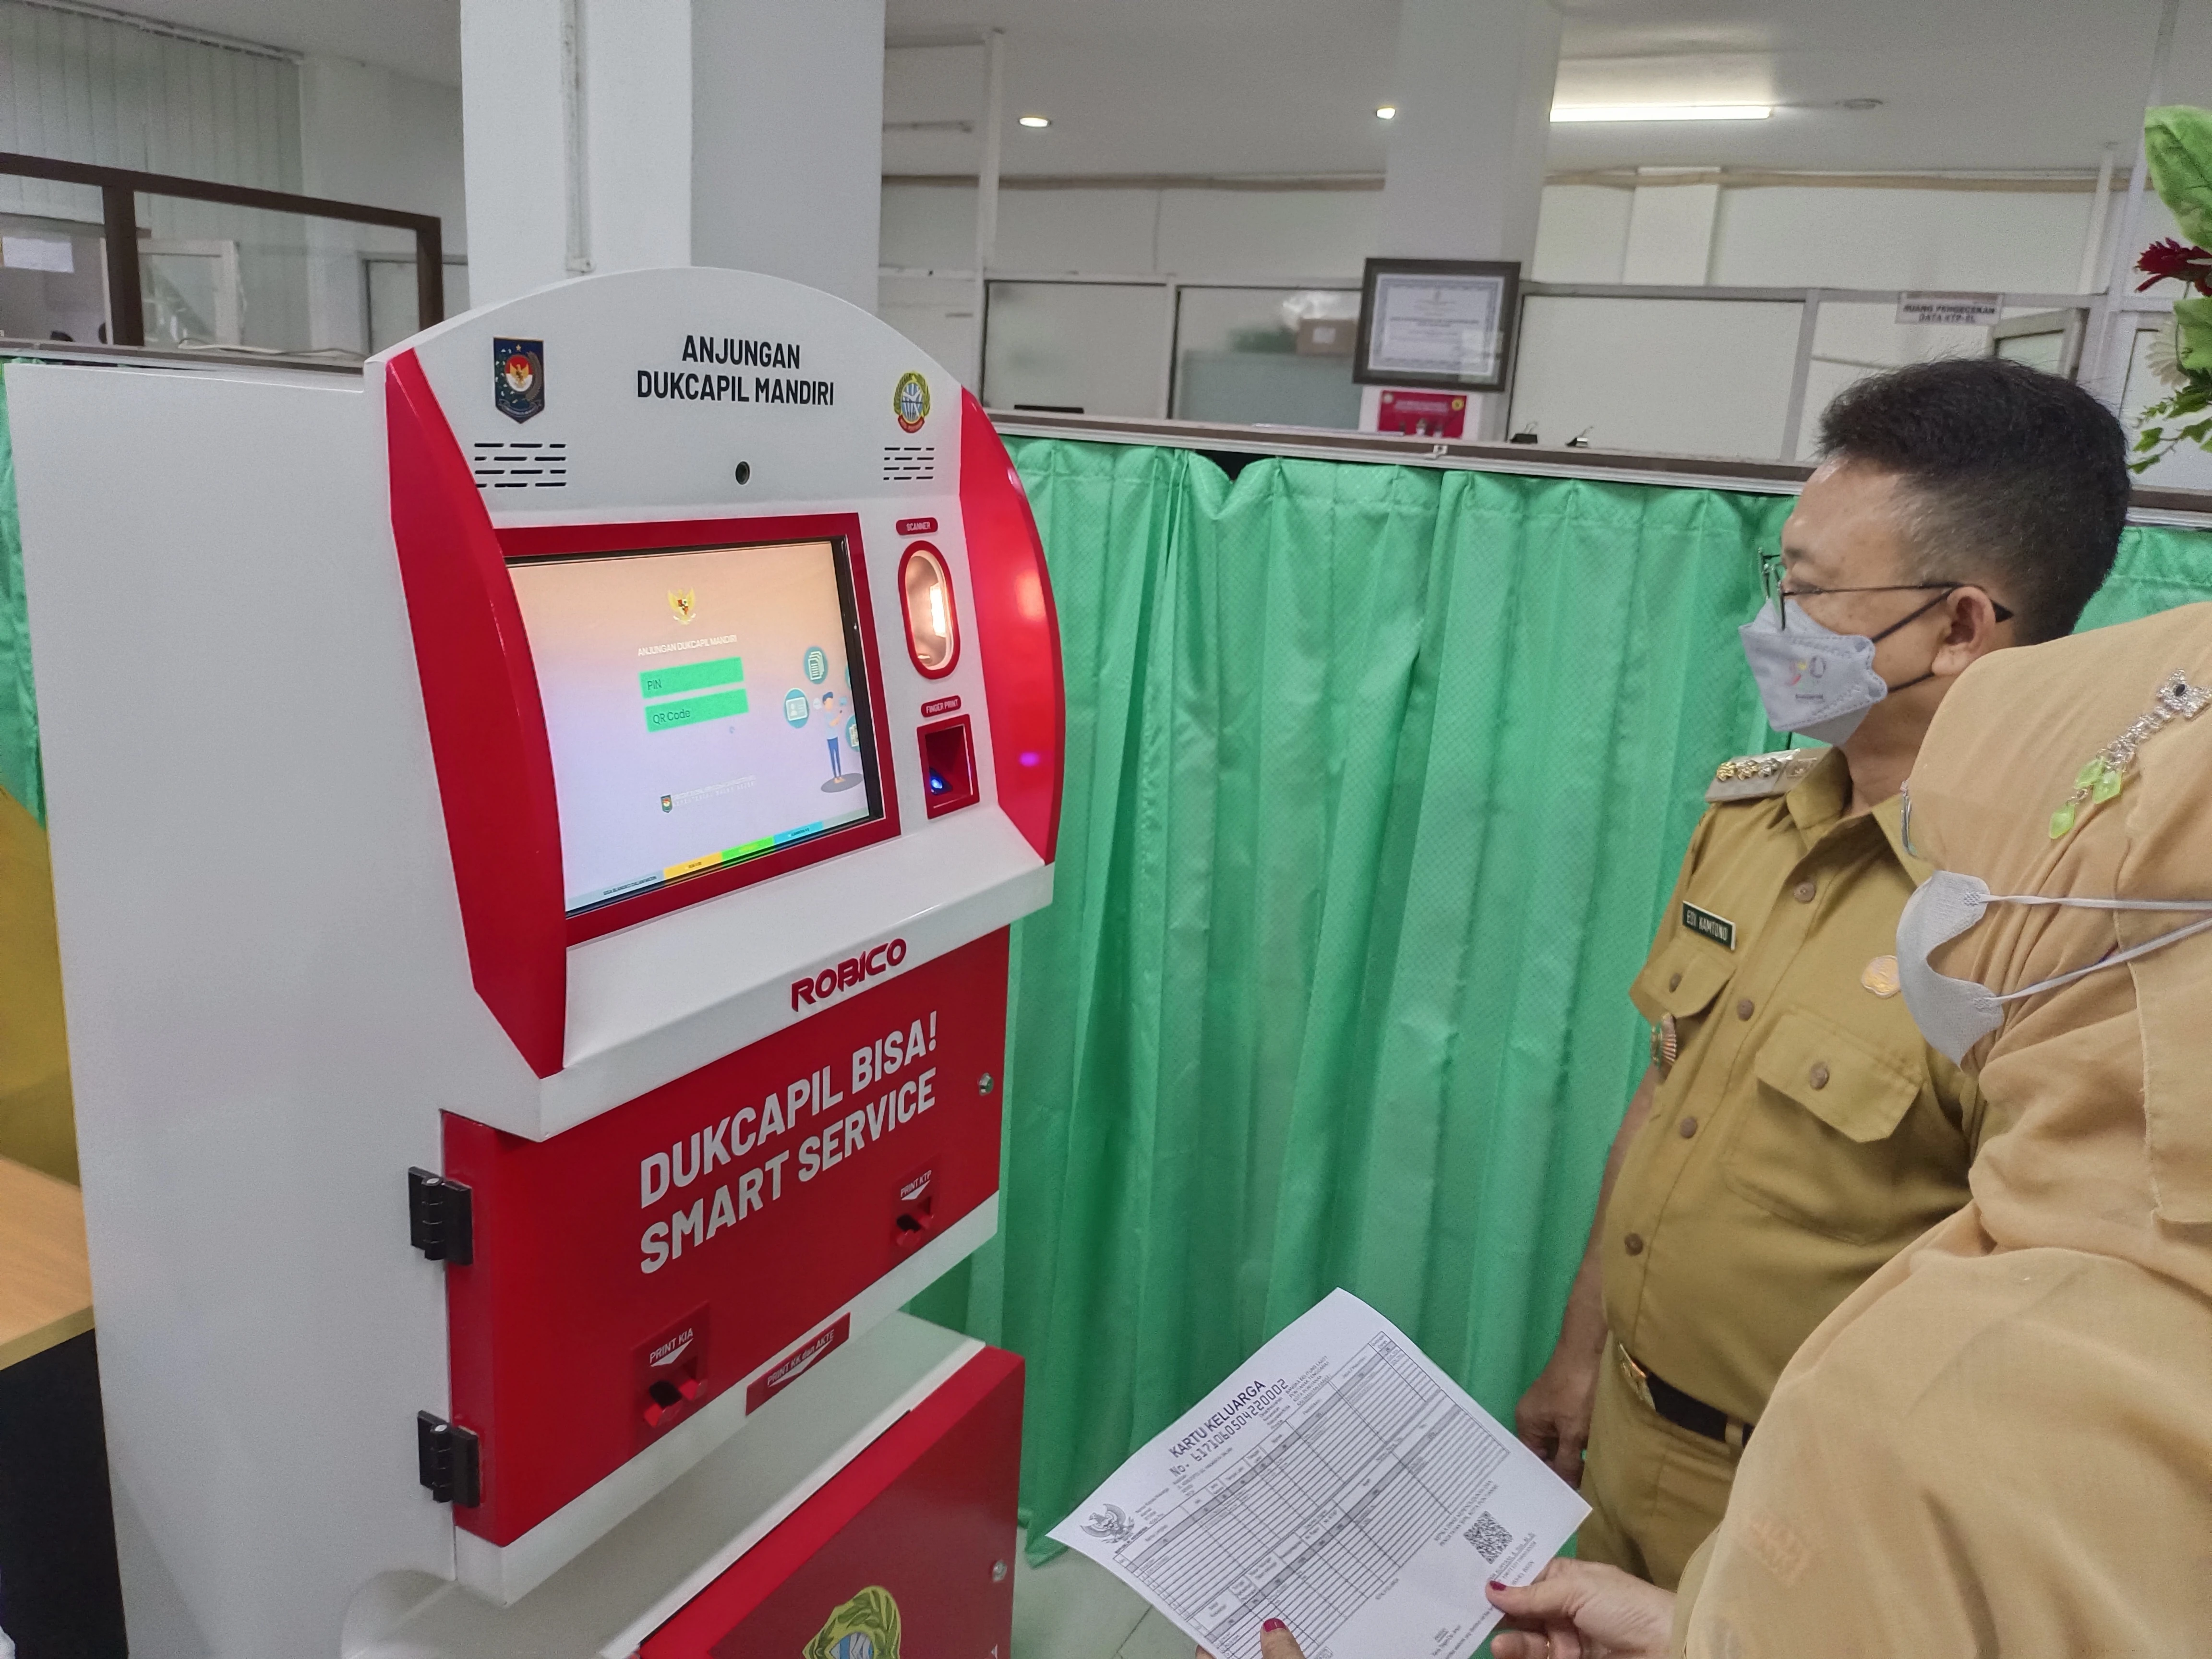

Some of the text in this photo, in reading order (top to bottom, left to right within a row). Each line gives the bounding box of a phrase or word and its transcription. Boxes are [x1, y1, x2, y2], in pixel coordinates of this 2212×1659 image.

[1920, 313, 1942, 323] DATA
[682, 334, 801, 369] ANJUNGAN
[637, 370, 834, 406] DUKCAPIL MANDIRI
[906, 521, 931, 531] SCANNER
[638, 635, 737, 657] ANJUNGAN DUKCAPIL MANDIRI
[647, 679, 662, 690] PIN
[652, 709, 691, 724] QR Code
[926, 699, 958, 714] FINGER PRINT
[791, 938, 906, 1012] ROBICO
[640, 1010, 938, 1209] DUKCAPIL BISA!
[640, 1067, 936, 1274] SMART SERVICE
[901, 1170, 932, 1197] PRINT KTP
[650, 1328, 693, 1363] PRINT KIA
[768, 1329, 834, 1385] PRINT KK dan AKTE
[1168, 1427, 1208, 1458] KARTU
[1204, 1380, 1266, 1432] KELUARGA
[1168, 1464, 1190, 1477] No.
[1190, 1378, 1288, 1462] 6171060504220002
